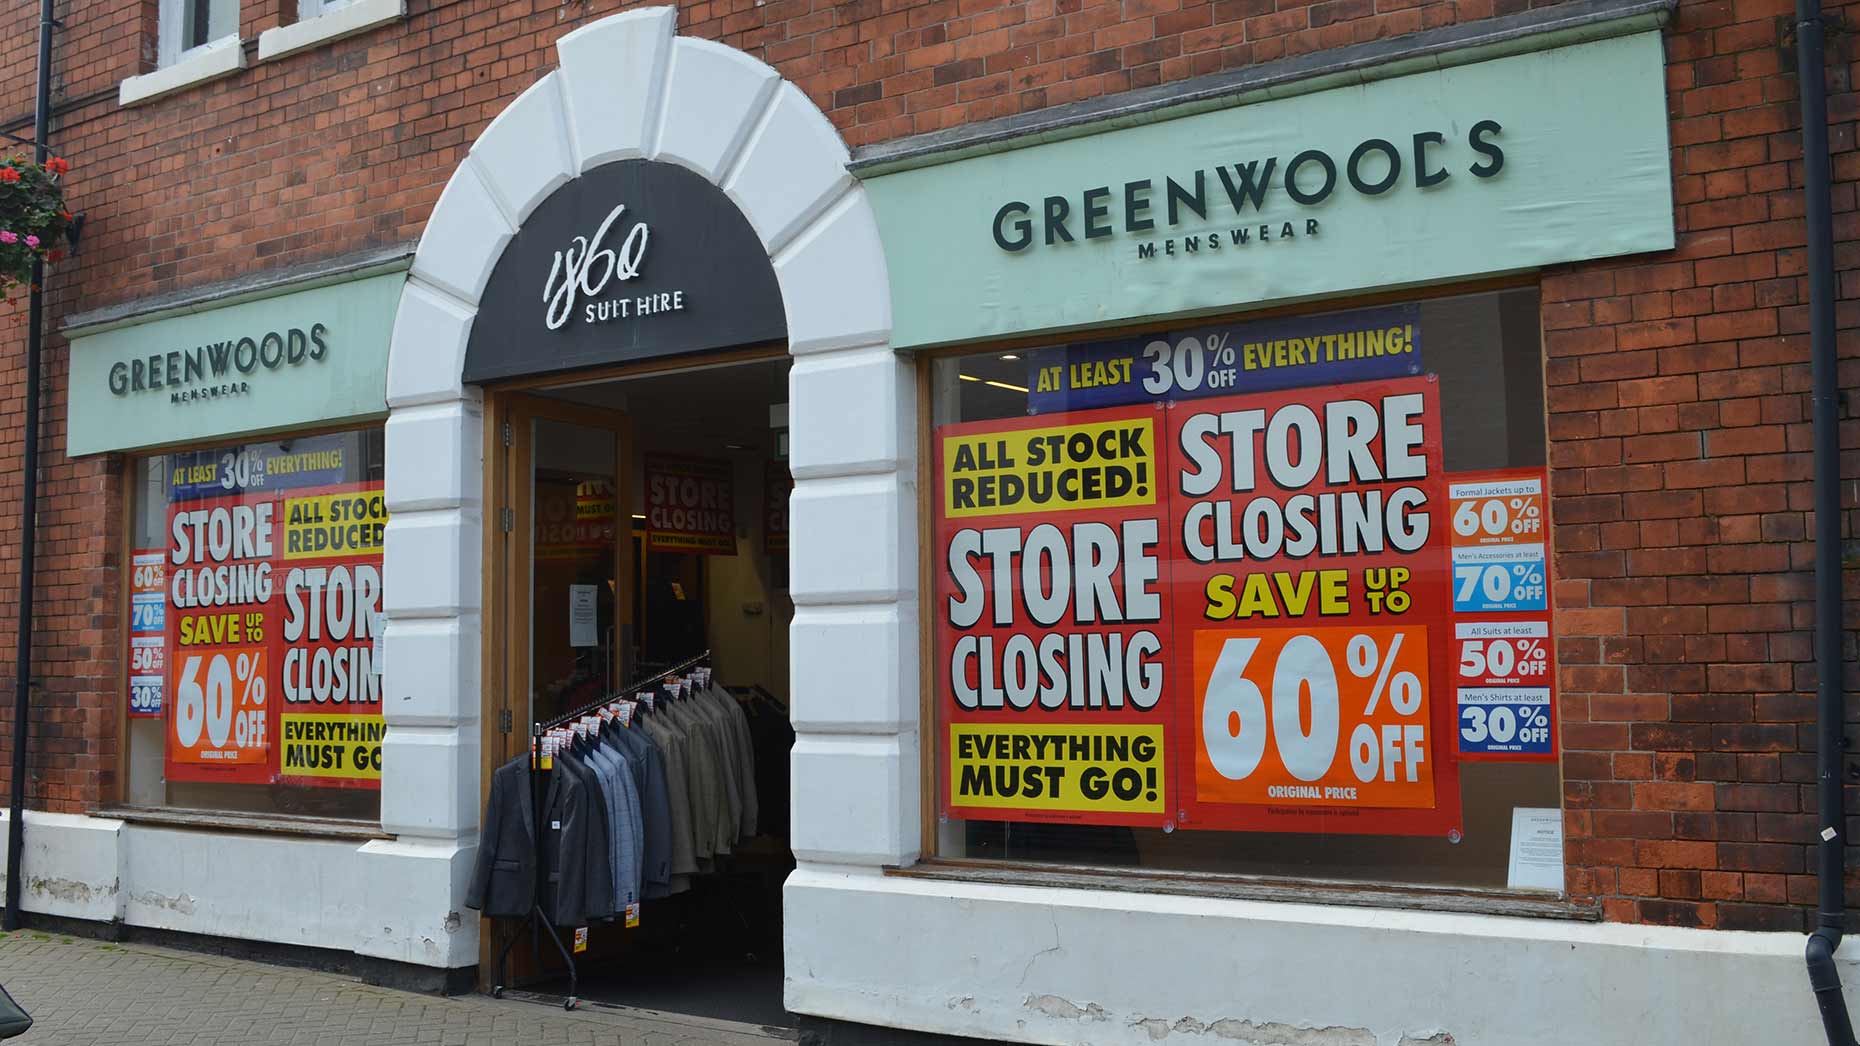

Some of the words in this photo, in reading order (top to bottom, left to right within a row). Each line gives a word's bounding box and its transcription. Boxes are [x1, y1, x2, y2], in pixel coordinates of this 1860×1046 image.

[991, 119, 1504, 252] GREENWOODS
[1138, 218, 1320, 259] MENSWEAR
[543, 204, 648, 330] 1860
[585, 298, 631, 323] SUIT
[637, 290, 683, 316] HIRE
[108, 322, 328, 396] GREENWOODS
[1036, 367, 1062, 393] AT
[1069, 357, 1134, 390] LEAST
[1142, 332, 1235, 396] 30%
[1207, 369, 1237, 389] OFF
[1243, 324, 1413, 371] EVERYTHING!
[170, 382, 249, 403] MENSWEAR
[952, 440, 1015, 472] ALL
[1026, 427, 1147, 466] STOCK
[1180, 392, 1428, 497] STORE
[172, 469, 185, 486] AT
[188, 463, 218, 484] LEAST
[250, 473, 264, 487] OFF
[266, 448, 343, 475] EVERYTHING!
[952, 462, 1149, 509] REDUCED!
[649, 474, 729, 510] STORE
[1456, 487, 1482, 497] Formal
[1484, 486, 1512, 496] Jackets
[1513, 487, 1524, 495] up
[1526, 486, 1535, 494] to
[288, 501, 323, 526] ALL
[650, 505, 731, 533] CLOSING
[1182, 486, 1431, 564] CLOSING
[1453, 497, 1540, 537] 60%
[1511, 518, 1541, 534] OFF
[170, 502, 273, 565] STORE
[170, 560, 273, 609] CLOSING
[948, 518, 1162, 629] STORE
[1364, 567, 1411, 591] UP
[1455, 564, 1543, 602] 70%
[1513, 585, 1543, 601] OFF
[282, 564, 383, 643] STOR
[1204, 569, 1350, 620] SAVE
[1365, 590, 1411, 614] TO
[179, 613, 239, 646] SAVE
[245, 613, 263, 628] UP
[246, 627, 264, 643] TO
[1471, 627, 1481, 636] All
[1483, 627, 1502, 635] Suits
[1512, 627, 1532, 635] least
[283, 646, 384, 705] CLOSIN
[950, 630, 1164, 711] CLOSING
[1459, 639, 1547, 677] 50%
[1517, 660, 1547, 676] OFF
[175, 652, 267, 748] 60%
[235, 710, 267, 748] OFF
[1202, 633, 1423, 782] 60%
[1350, 723, 1425, 783] OFF
[1464, 693, 1488, 702] Men's
[1490, 693, 1512, 702] Shirts
[1523, 693, 1543, 702] least
[285, 720, 387, 742] EVERYTHIN
[1461, 706, 1548, 743] 30%
[1519, 728, 1549, 743] OFF
[286, 743, 344, 769] MUST
[958, 734, 1157, 763] EVERYTHING
[959, 765, 1066, 799] MUST
[1079, 766, 1158, 802] GO!
[1267, 785, 1322, 799] ORIGINAL
[1324, 786, 1358, 801] PRICE
